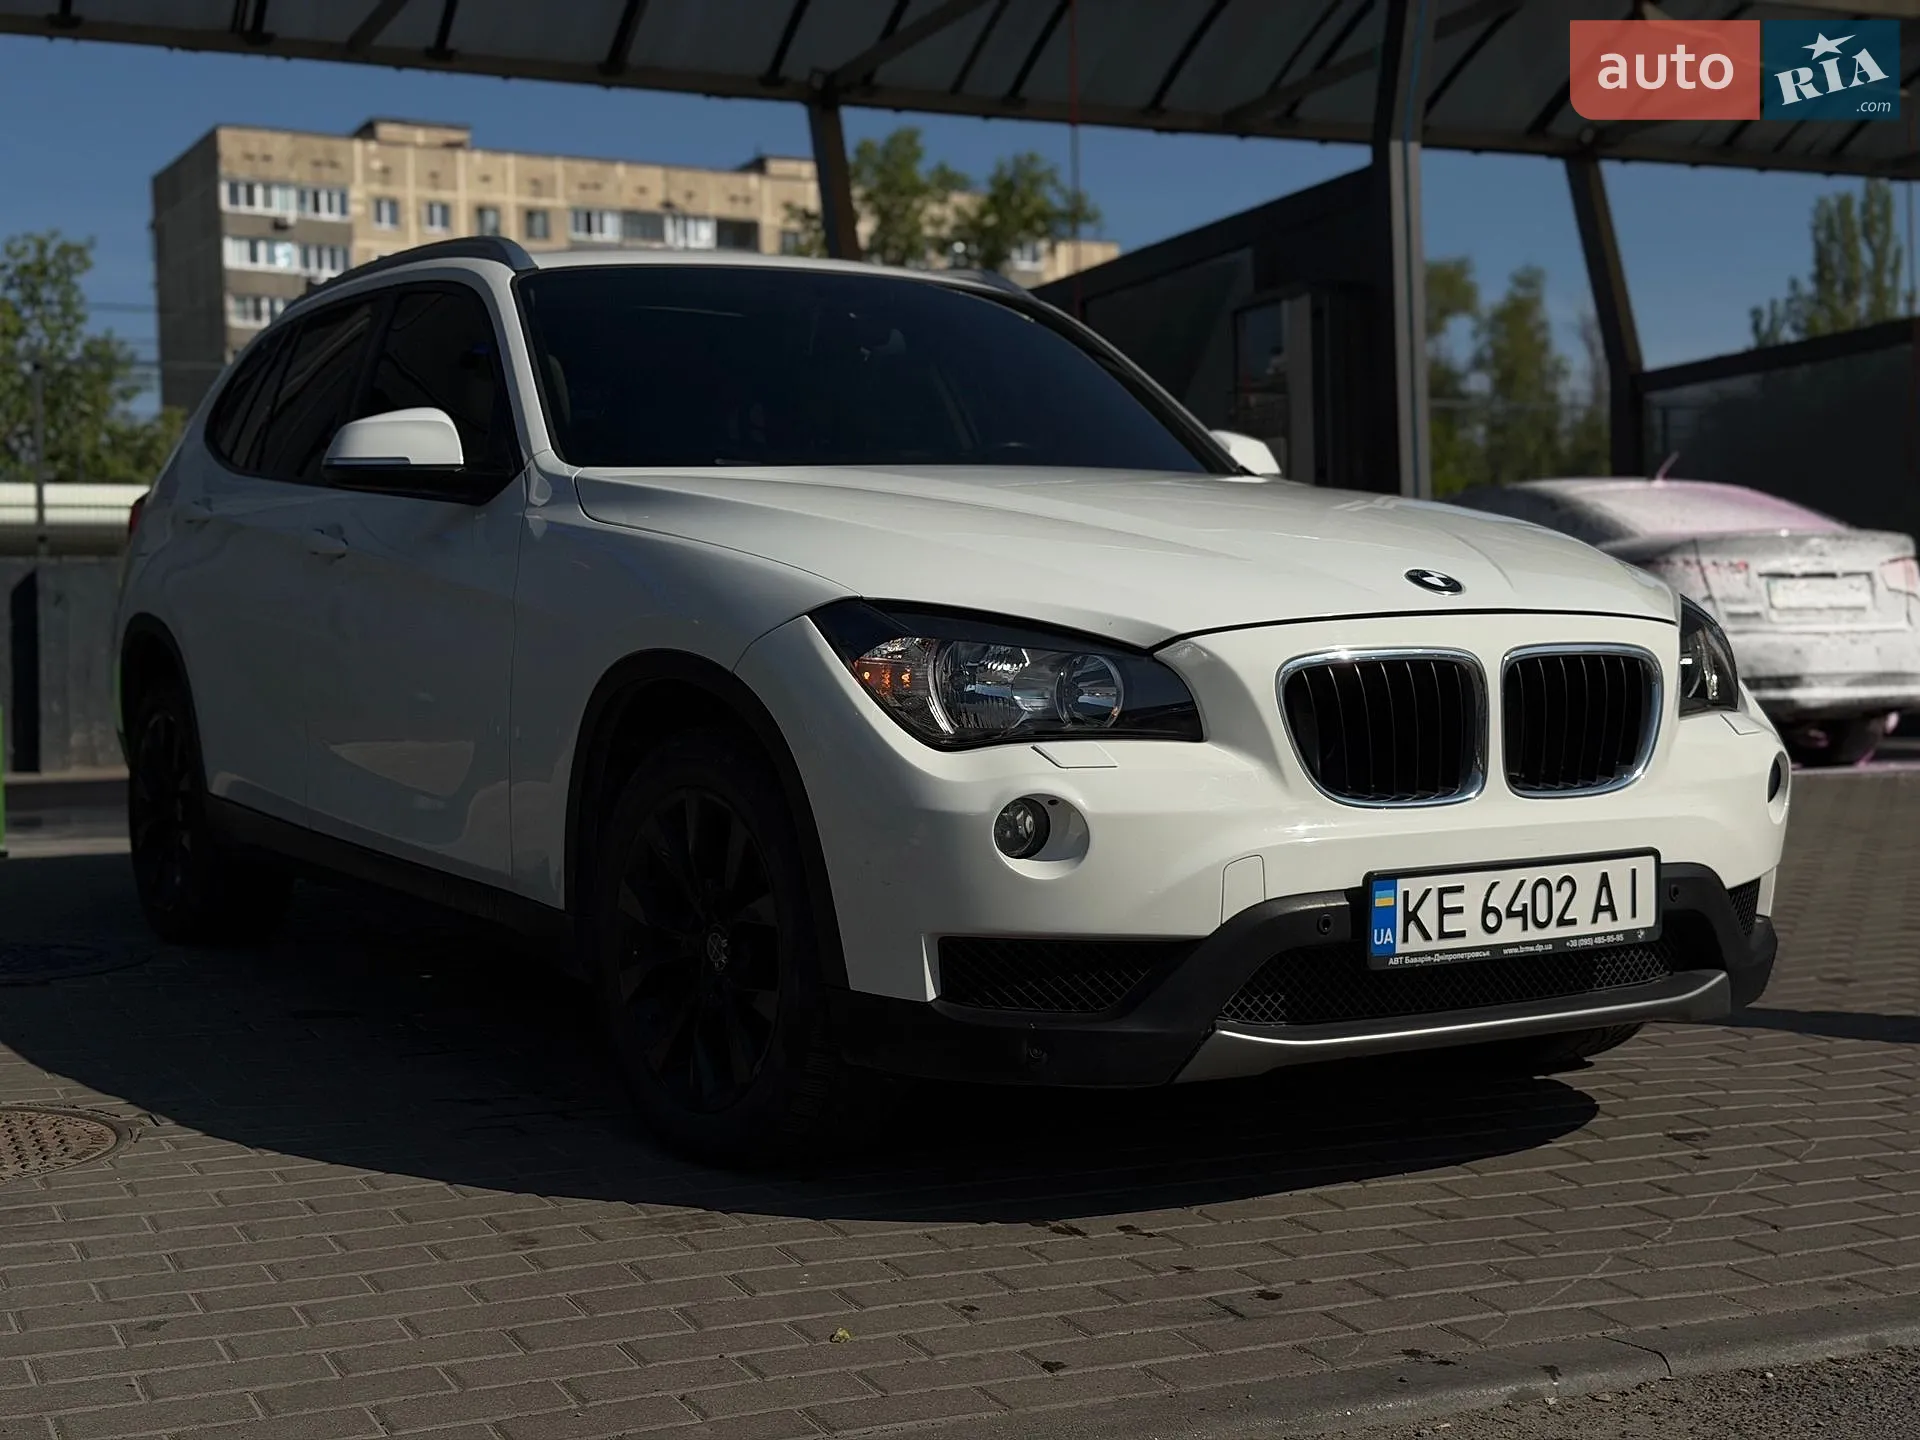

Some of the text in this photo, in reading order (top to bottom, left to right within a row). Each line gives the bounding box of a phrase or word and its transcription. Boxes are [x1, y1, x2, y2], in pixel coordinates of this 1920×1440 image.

[1401, 867, 1638, 944] KE 6402 AI
[1373, 926, 1394, 946] UA
